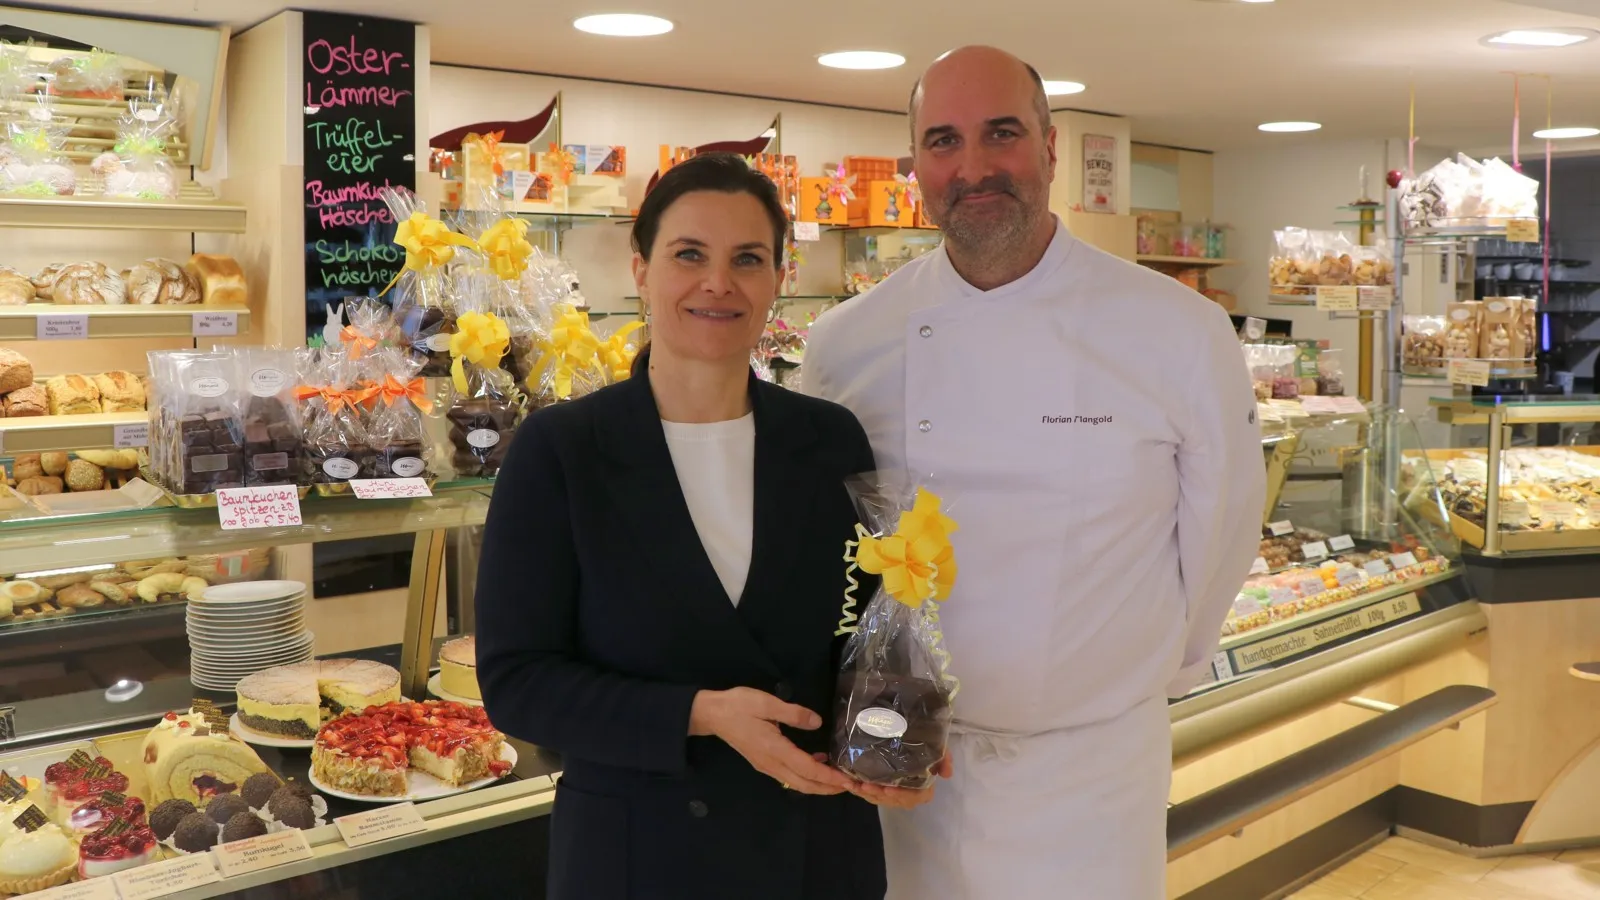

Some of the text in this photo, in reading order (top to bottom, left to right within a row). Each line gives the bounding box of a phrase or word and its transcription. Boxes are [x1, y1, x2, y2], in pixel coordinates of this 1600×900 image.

[308, 35, 410, 75] Oster-
[307, 80, 412, 108] Lämmer
[307, 118, 403, 155] Trüffel-
[326, 152, 383, 174] eier
[1042, 415, 1072, 424] Florian
[1241, 634, 1308, 666] handgemachte
[1312, 613, 1362, 642] Sahnetrüffel
[1367, 609, 1386, 625] 100g
